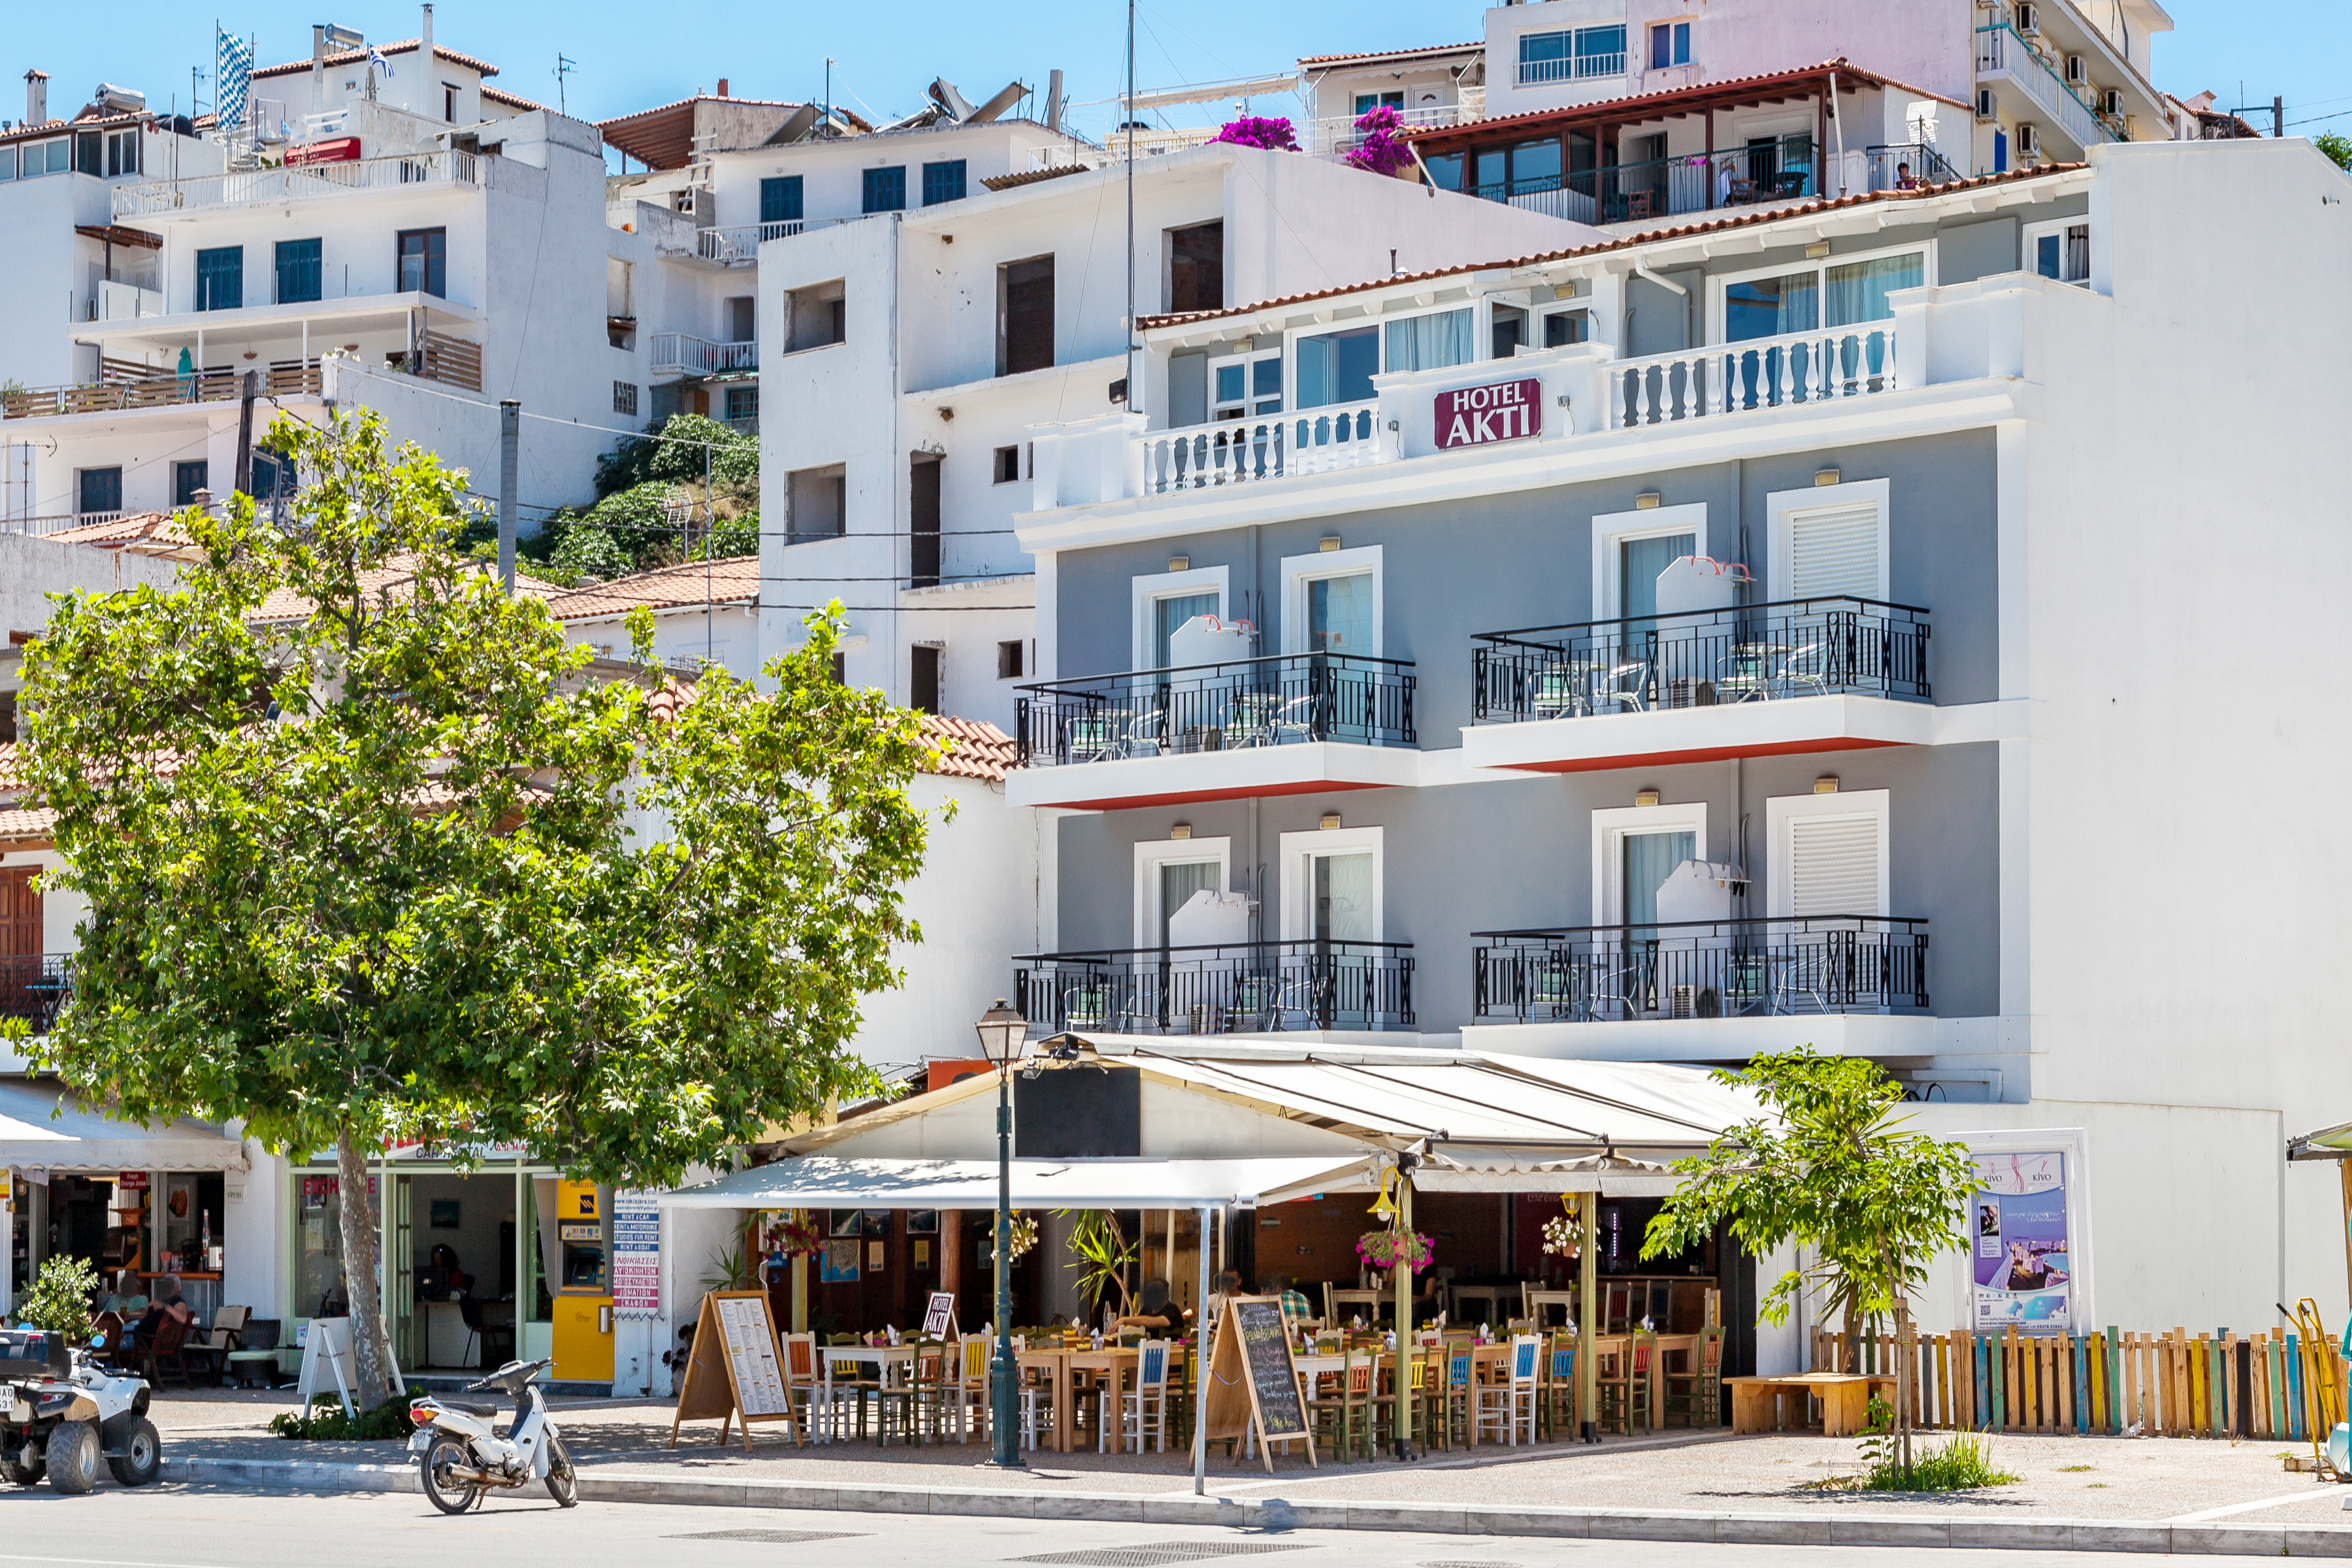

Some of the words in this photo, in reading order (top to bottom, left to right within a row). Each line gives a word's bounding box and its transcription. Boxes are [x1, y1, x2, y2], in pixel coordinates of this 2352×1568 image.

[1454, 382, 1525, 412] HOTEL
[1446, 404, 1529, 446] AKTI
[303, 1177, 376, 1195] EXCHE
[932, 1297, 949, 1311] HOTEL
[925, 1311, 947, 1332] AKTI
[0, 1388, 13, 1397] AO
